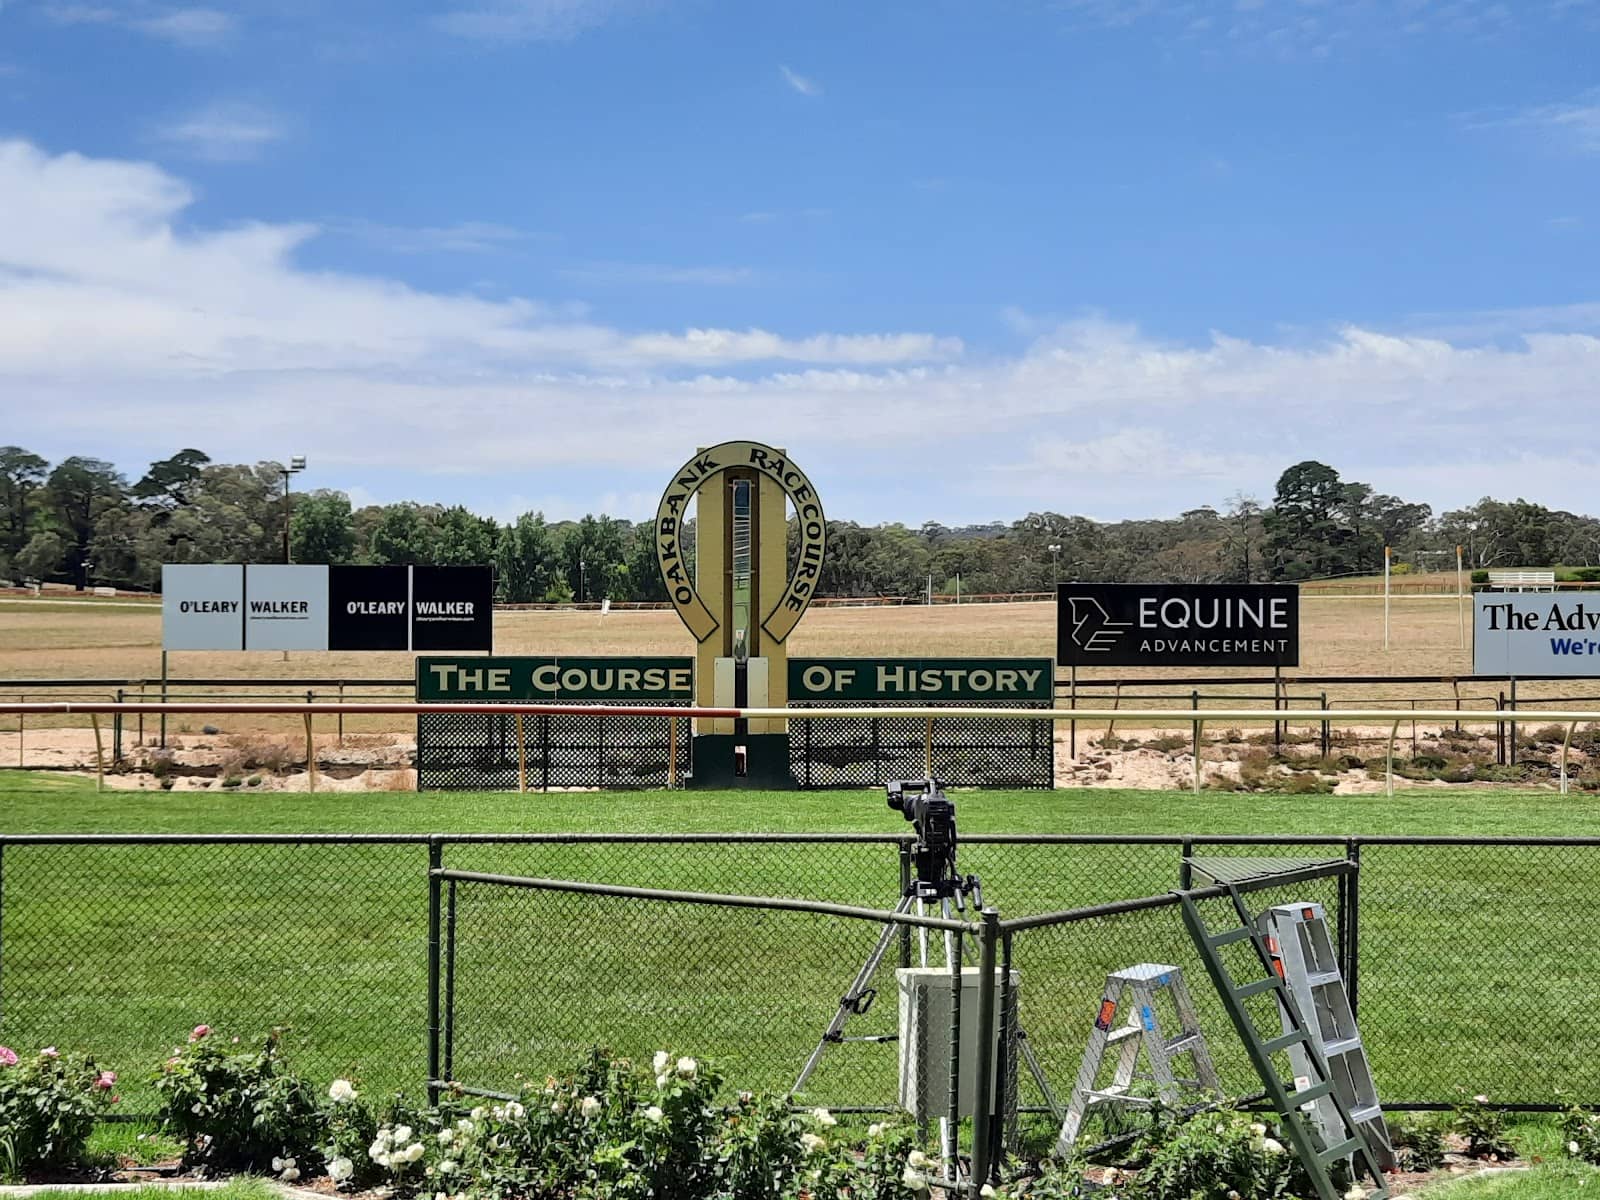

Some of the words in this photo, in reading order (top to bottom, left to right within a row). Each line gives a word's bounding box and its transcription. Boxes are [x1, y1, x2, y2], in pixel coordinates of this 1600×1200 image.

[660, 454, 721, 606] OAKBANK
[749, 447, 822, 613] RACECOURSE
[180, 601, 239, 613] O'LEARY
[250, 601, 308, 613] WALKER
[346, 602, 406, 615] O'LEARY
[416, 602, 474, 615] WALKER
[1139, 597, 1288, 629] EQUINE
[1482, 603, 1539, 631] The
[1541, 603, 1600, 631] Adv
[1139, 639, 1288, 653] ADVANCEMENT
[1550, 638, 1600, 655] We'r
[429, 664, 511, 691] THE
